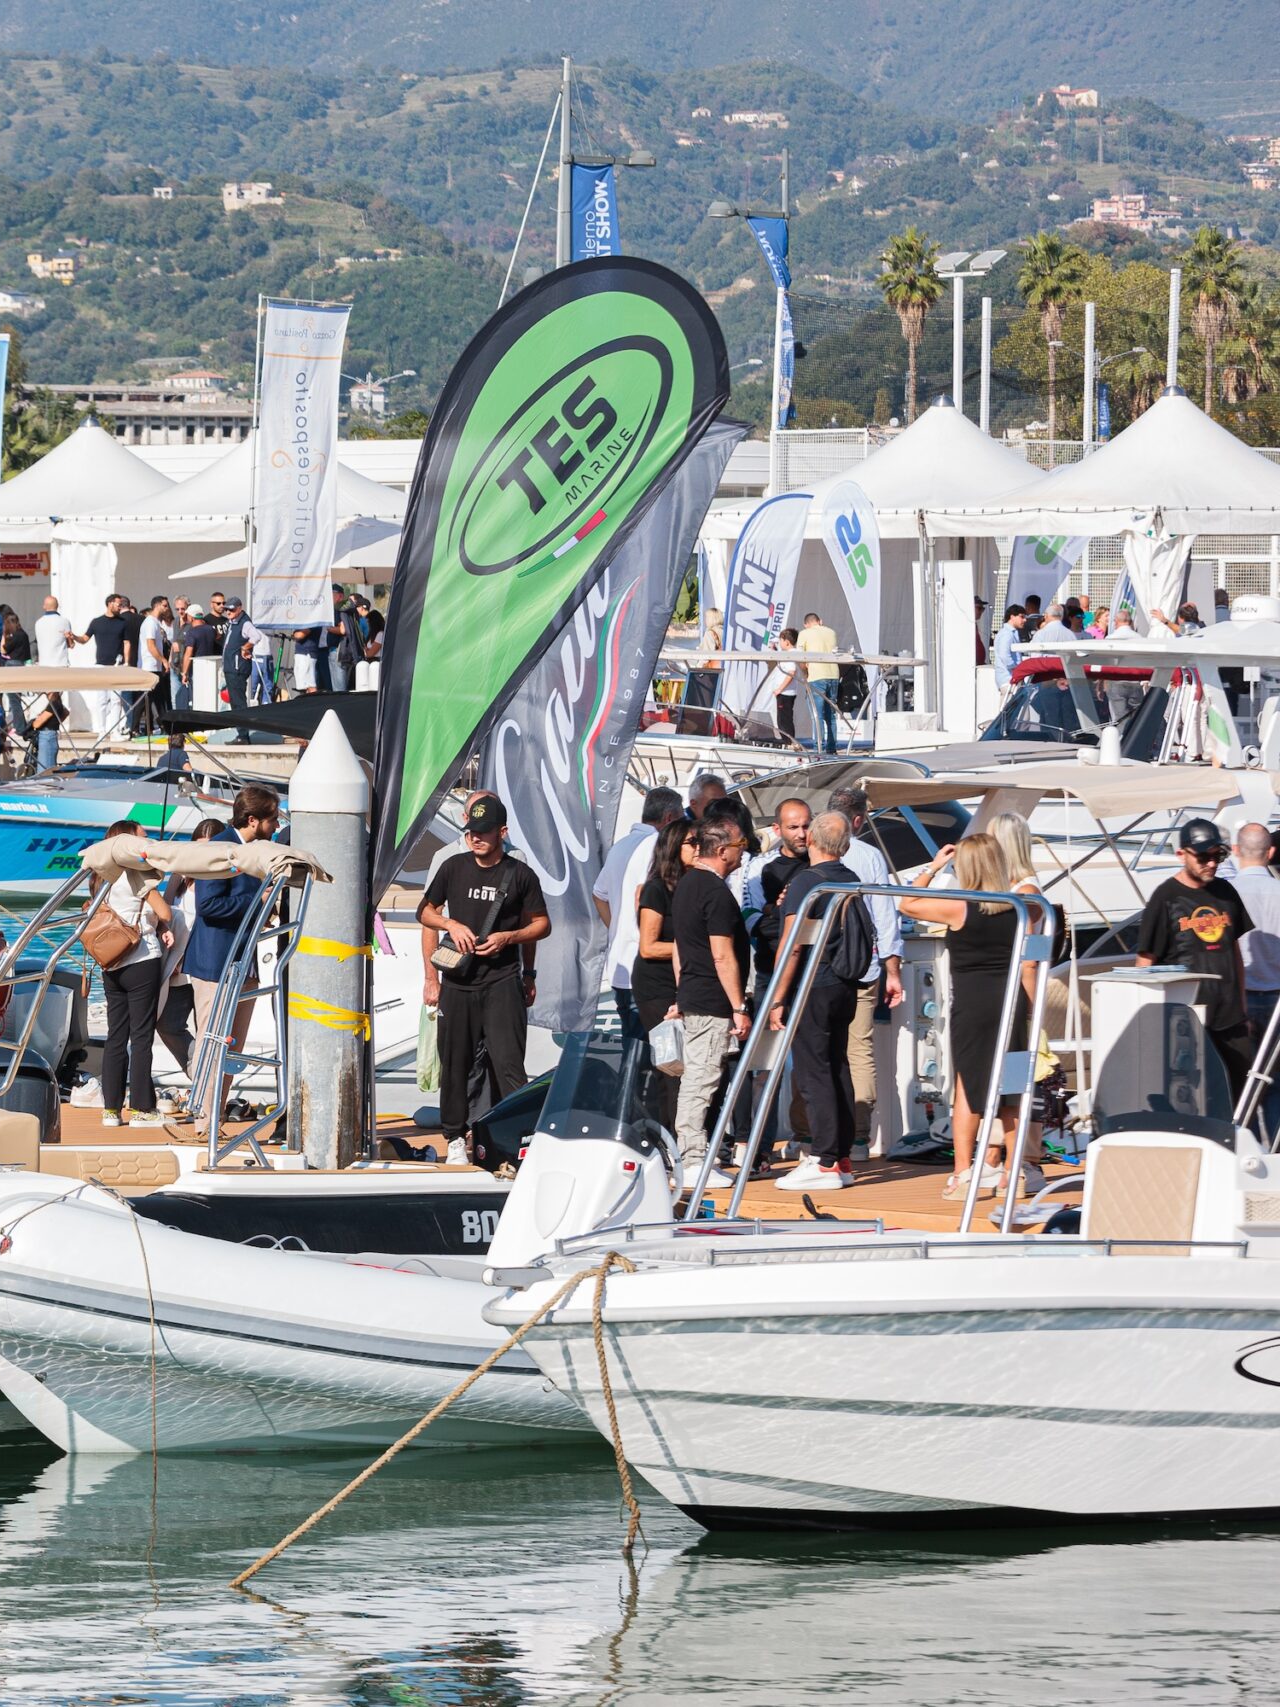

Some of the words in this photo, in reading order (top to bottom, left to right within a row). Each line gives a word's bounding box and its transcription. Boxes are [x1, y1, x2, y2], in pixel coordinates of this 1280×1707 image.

[593, 179, 612, 238] SHOW
[496, 375, 618, 516] TES
[564, 427, 634, 506] MARINE
[595, 733, 621, 831] SINCE
[618, 646, 646, 717] 1987
